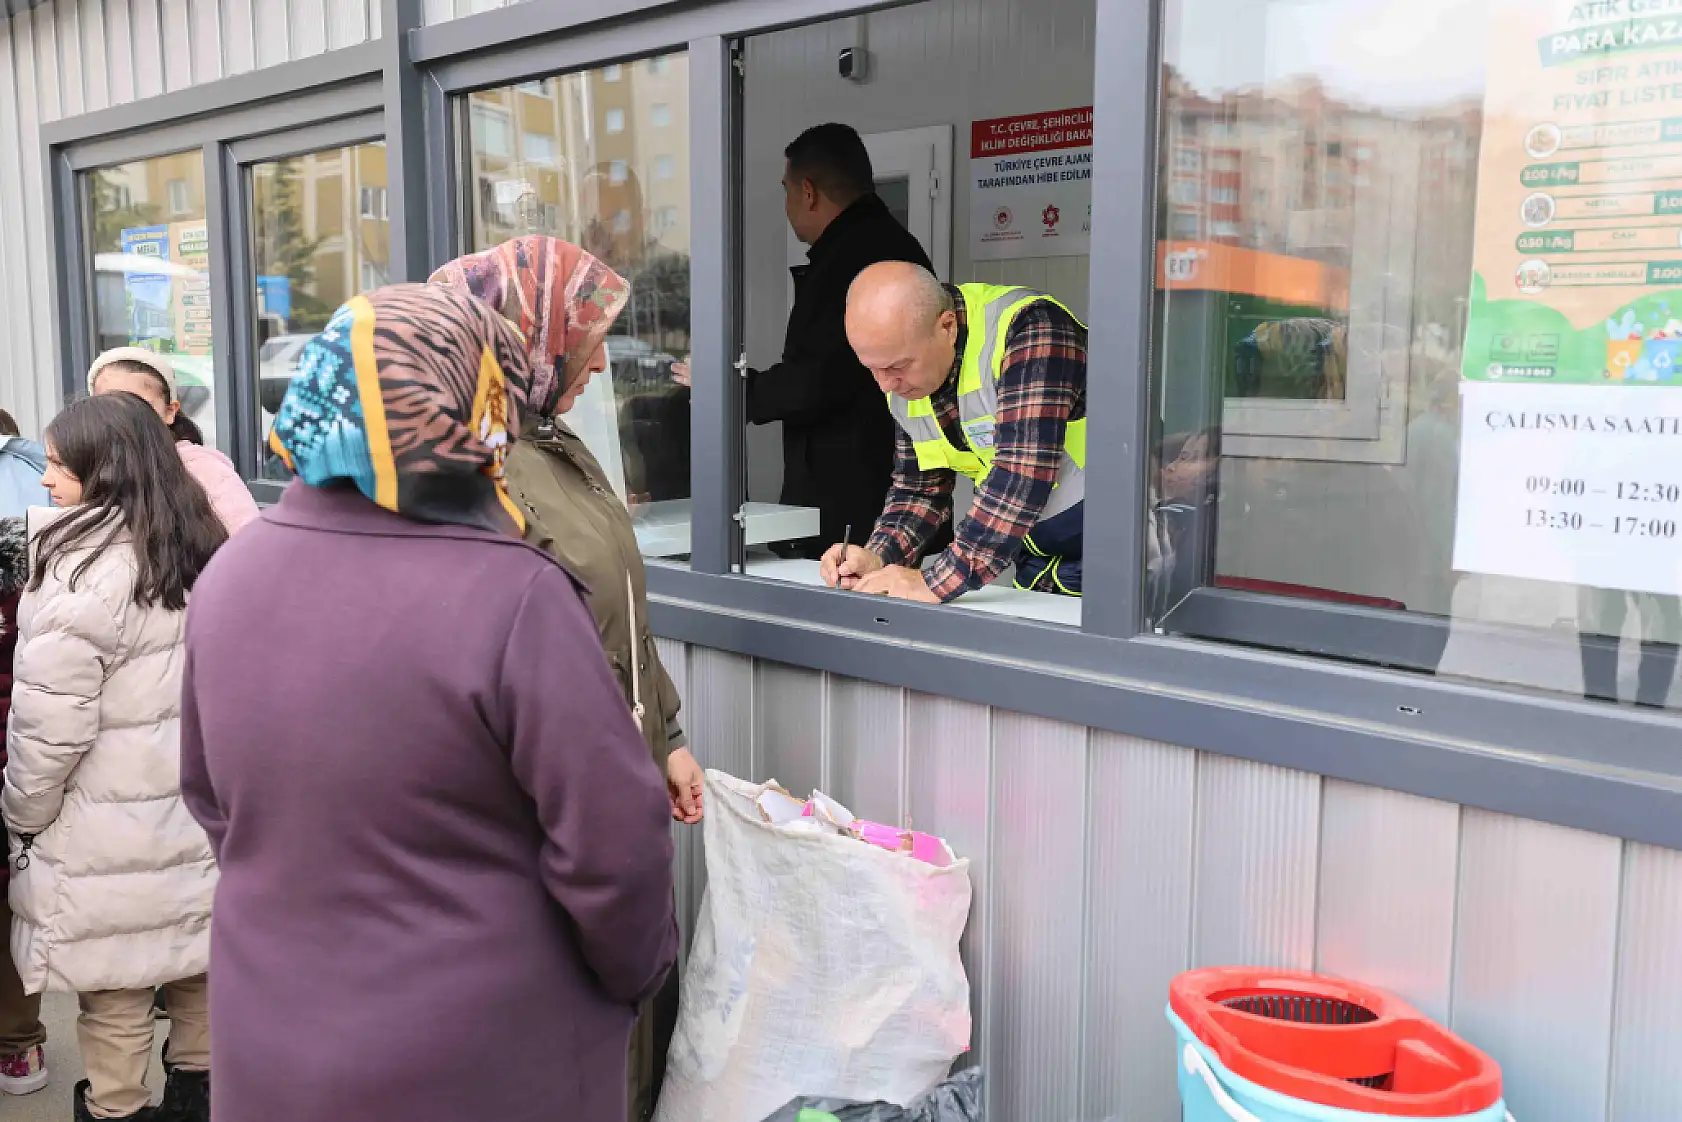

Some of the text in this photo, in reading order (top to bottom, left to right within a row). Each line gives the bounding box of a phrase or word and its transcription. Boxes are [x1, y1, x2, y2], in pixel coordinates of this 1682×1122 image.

[1552, 20, 1682, 53] PARA KAZ
[994, 158, 1032, 173] TÜRKİYE
[1034, 155, 1063, 170] ÇEVRE
[978, 174, 1035, 189] TARAFINDAN
[1485, 410, 1596, 433] ÇALIŞMA
[1526, 476, 1586, 497] 09:00
[1616, 481, 1680, 503] 12:30
[1524, 509, 1583, 531] 13:30
[1612, 516, 1677, 539] 17:00
